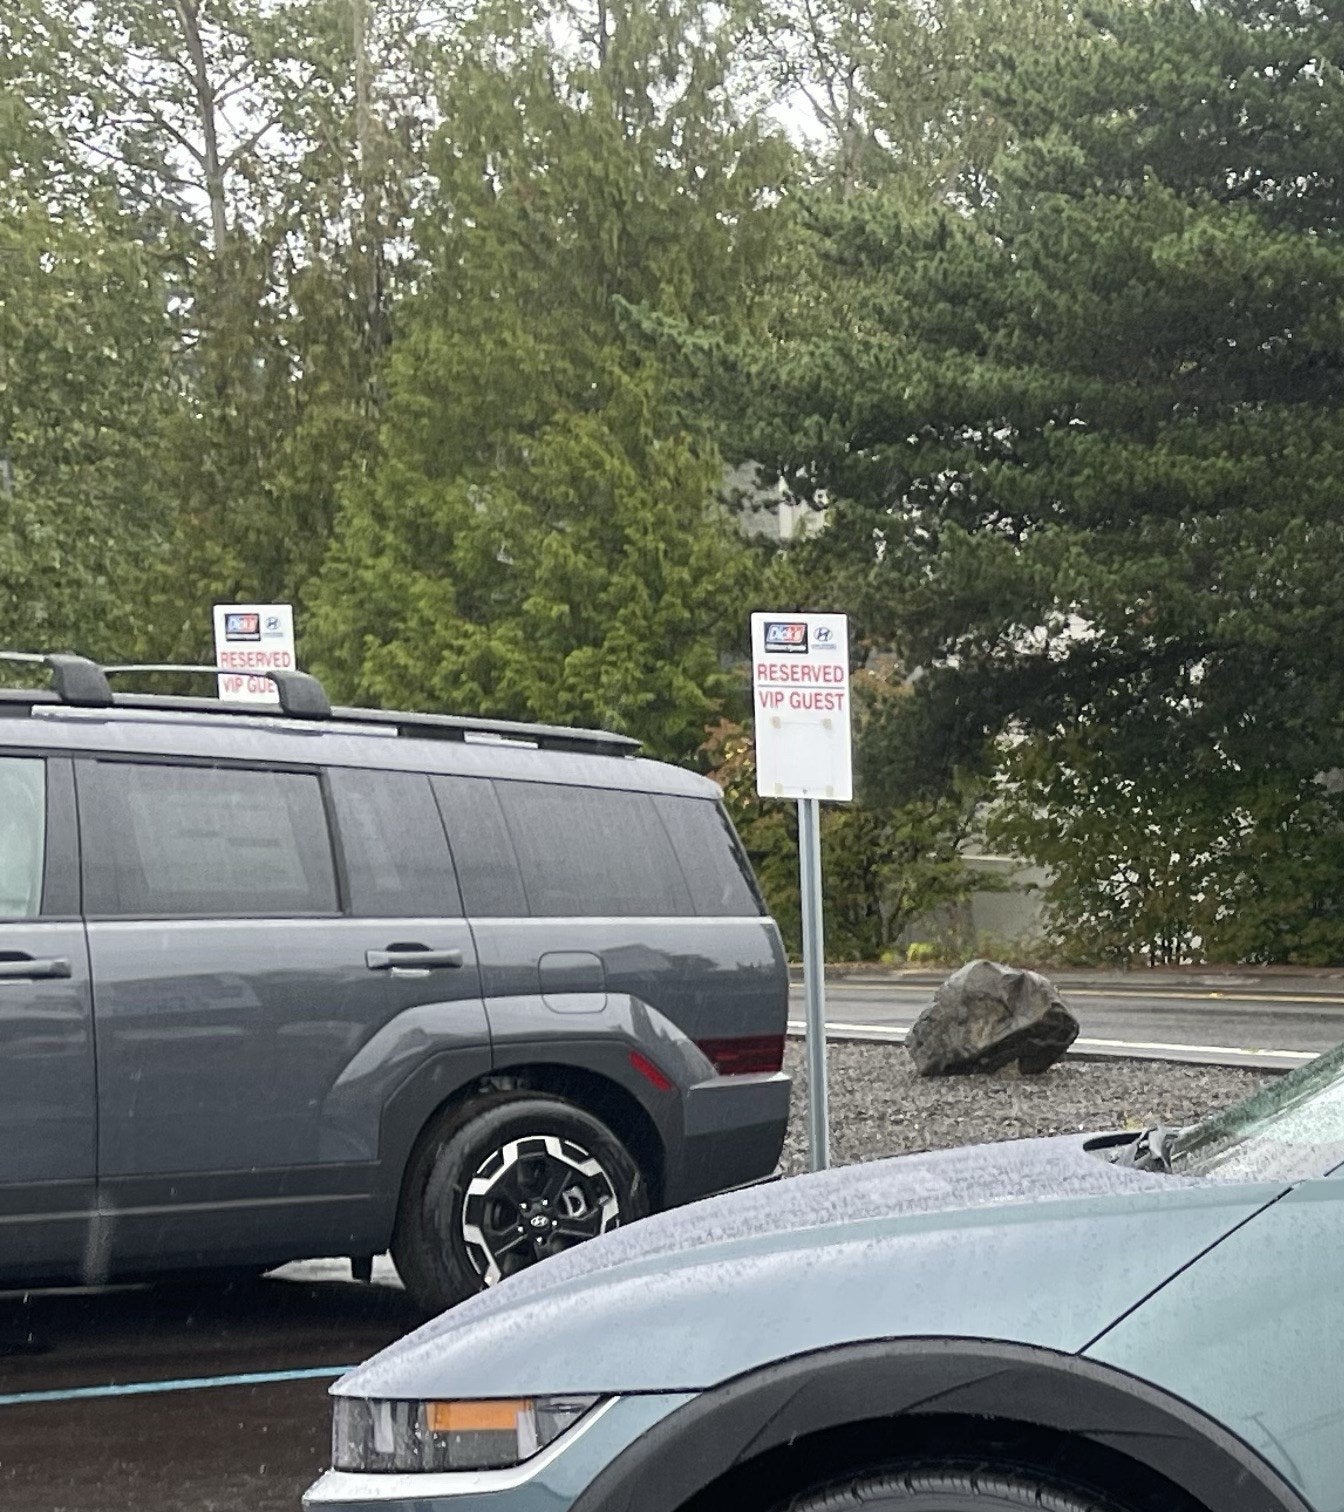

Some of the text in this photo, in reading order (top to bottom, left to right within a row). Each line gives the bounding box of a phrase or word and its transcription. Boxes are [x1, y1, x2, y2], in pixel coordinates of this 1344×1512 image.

[221, 651, 291, 668] RESERVED
[757, 663, 845, 683] RESERVED
[223, 676, 276, 693] VIP GUE
[759, 691, 845, 710] VIP GUEST
